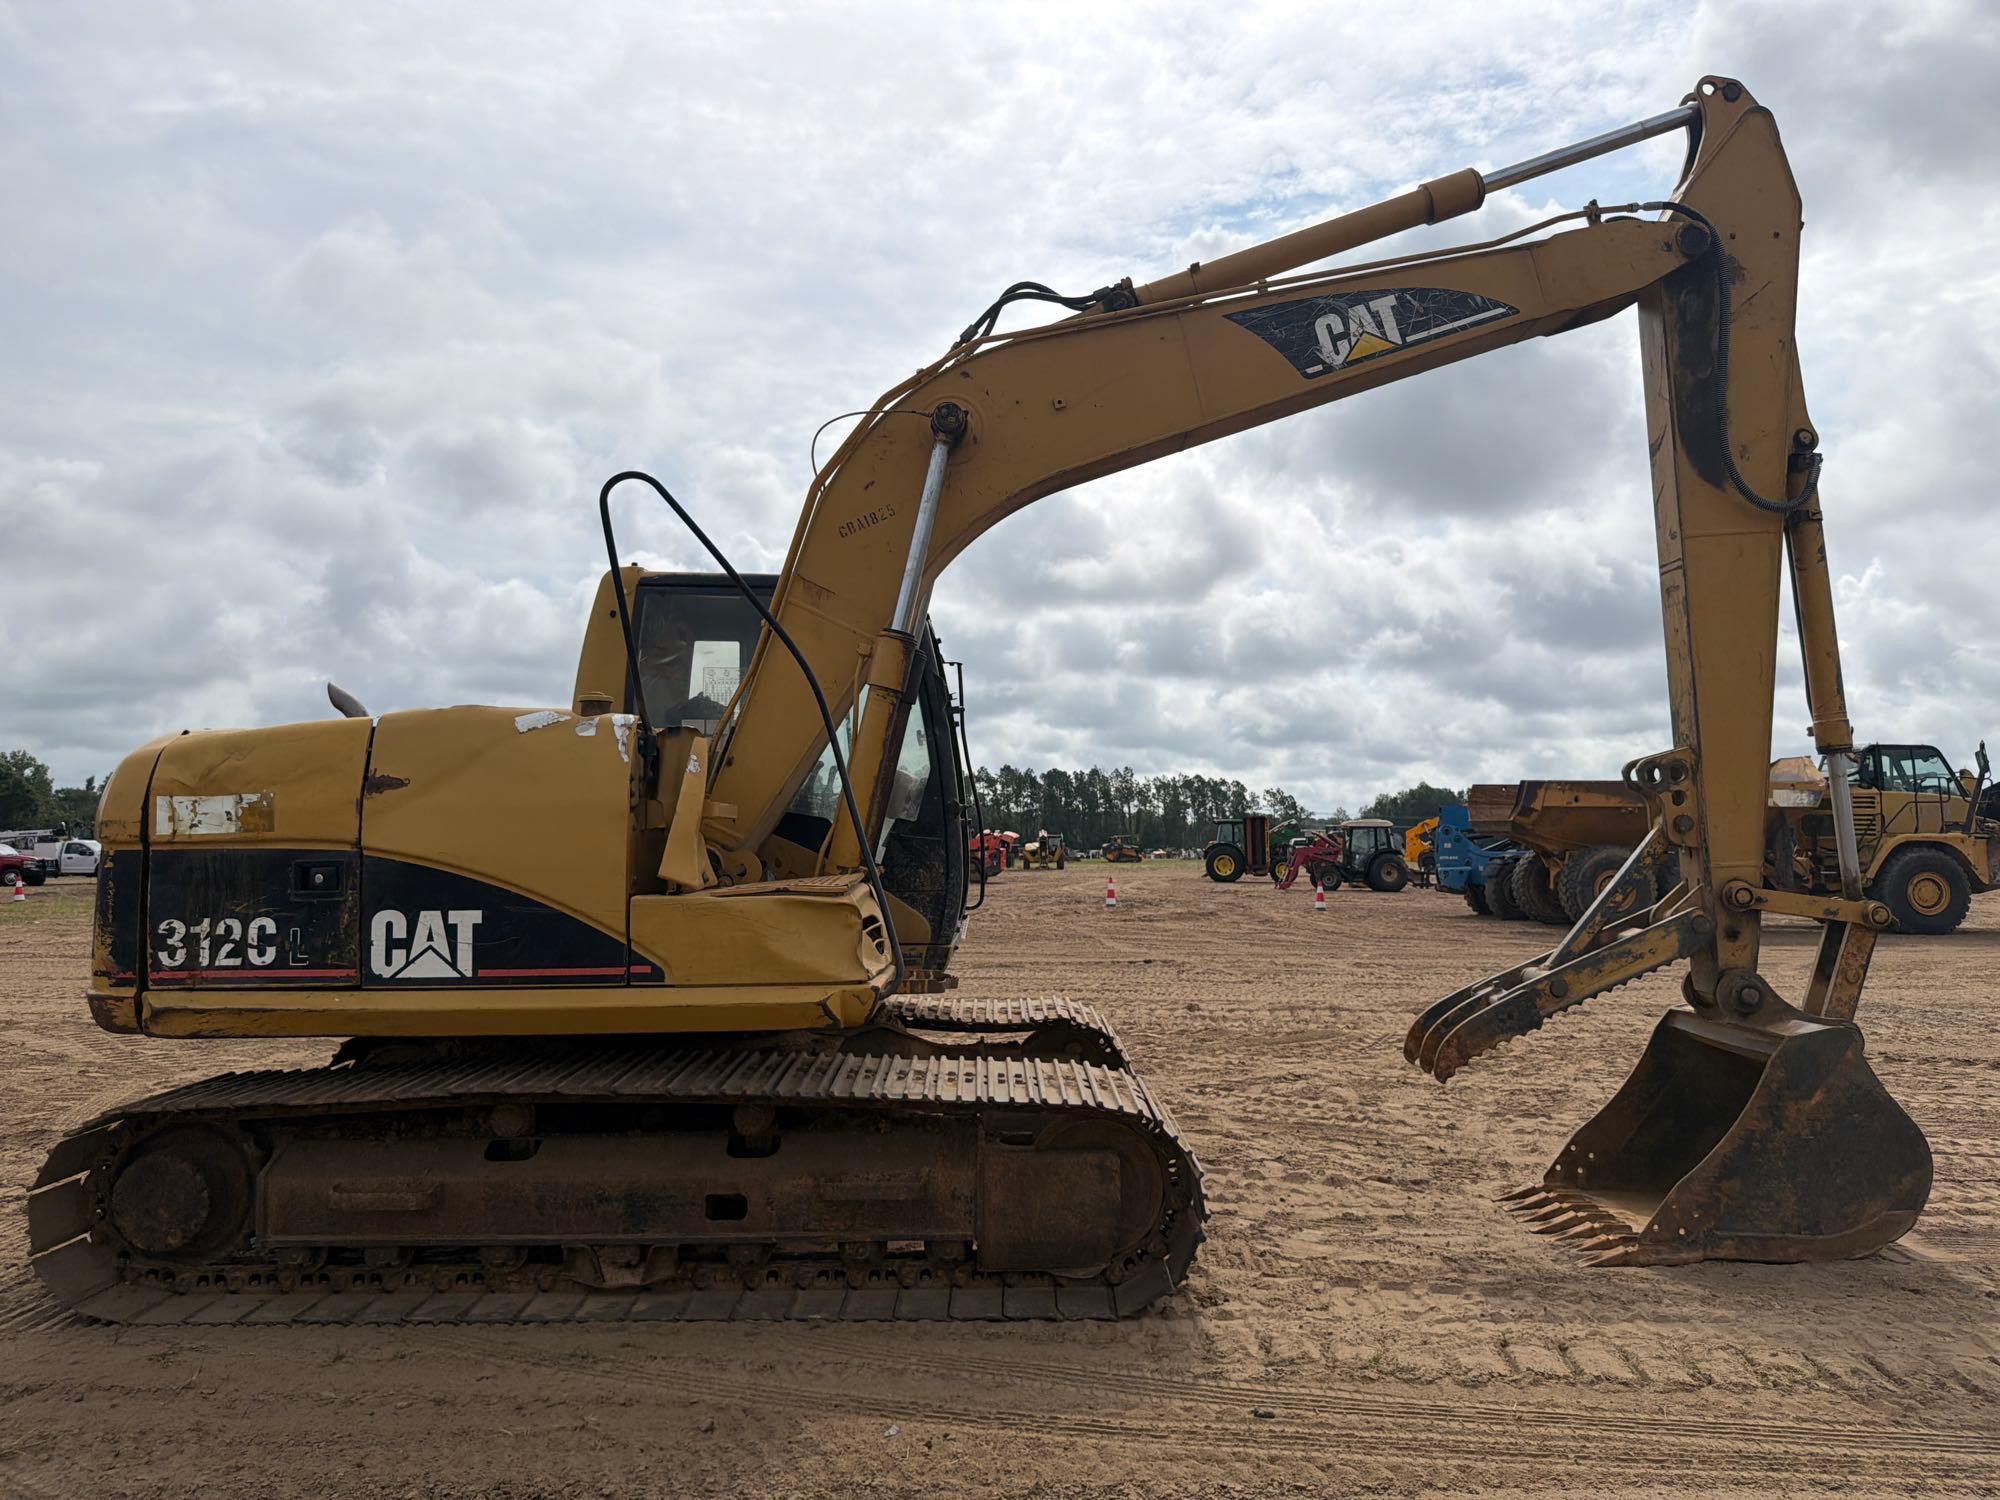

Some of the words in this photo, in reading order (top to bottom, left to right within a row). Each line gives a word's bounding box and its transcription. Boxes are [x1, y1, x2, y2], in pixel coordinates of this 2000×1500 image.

[1314, 294, 1402, 368] CAT
[157, 916, 277, 967] 312C
[289, 927, 309, 966] L
[370, 909, 483, 978] CAT
